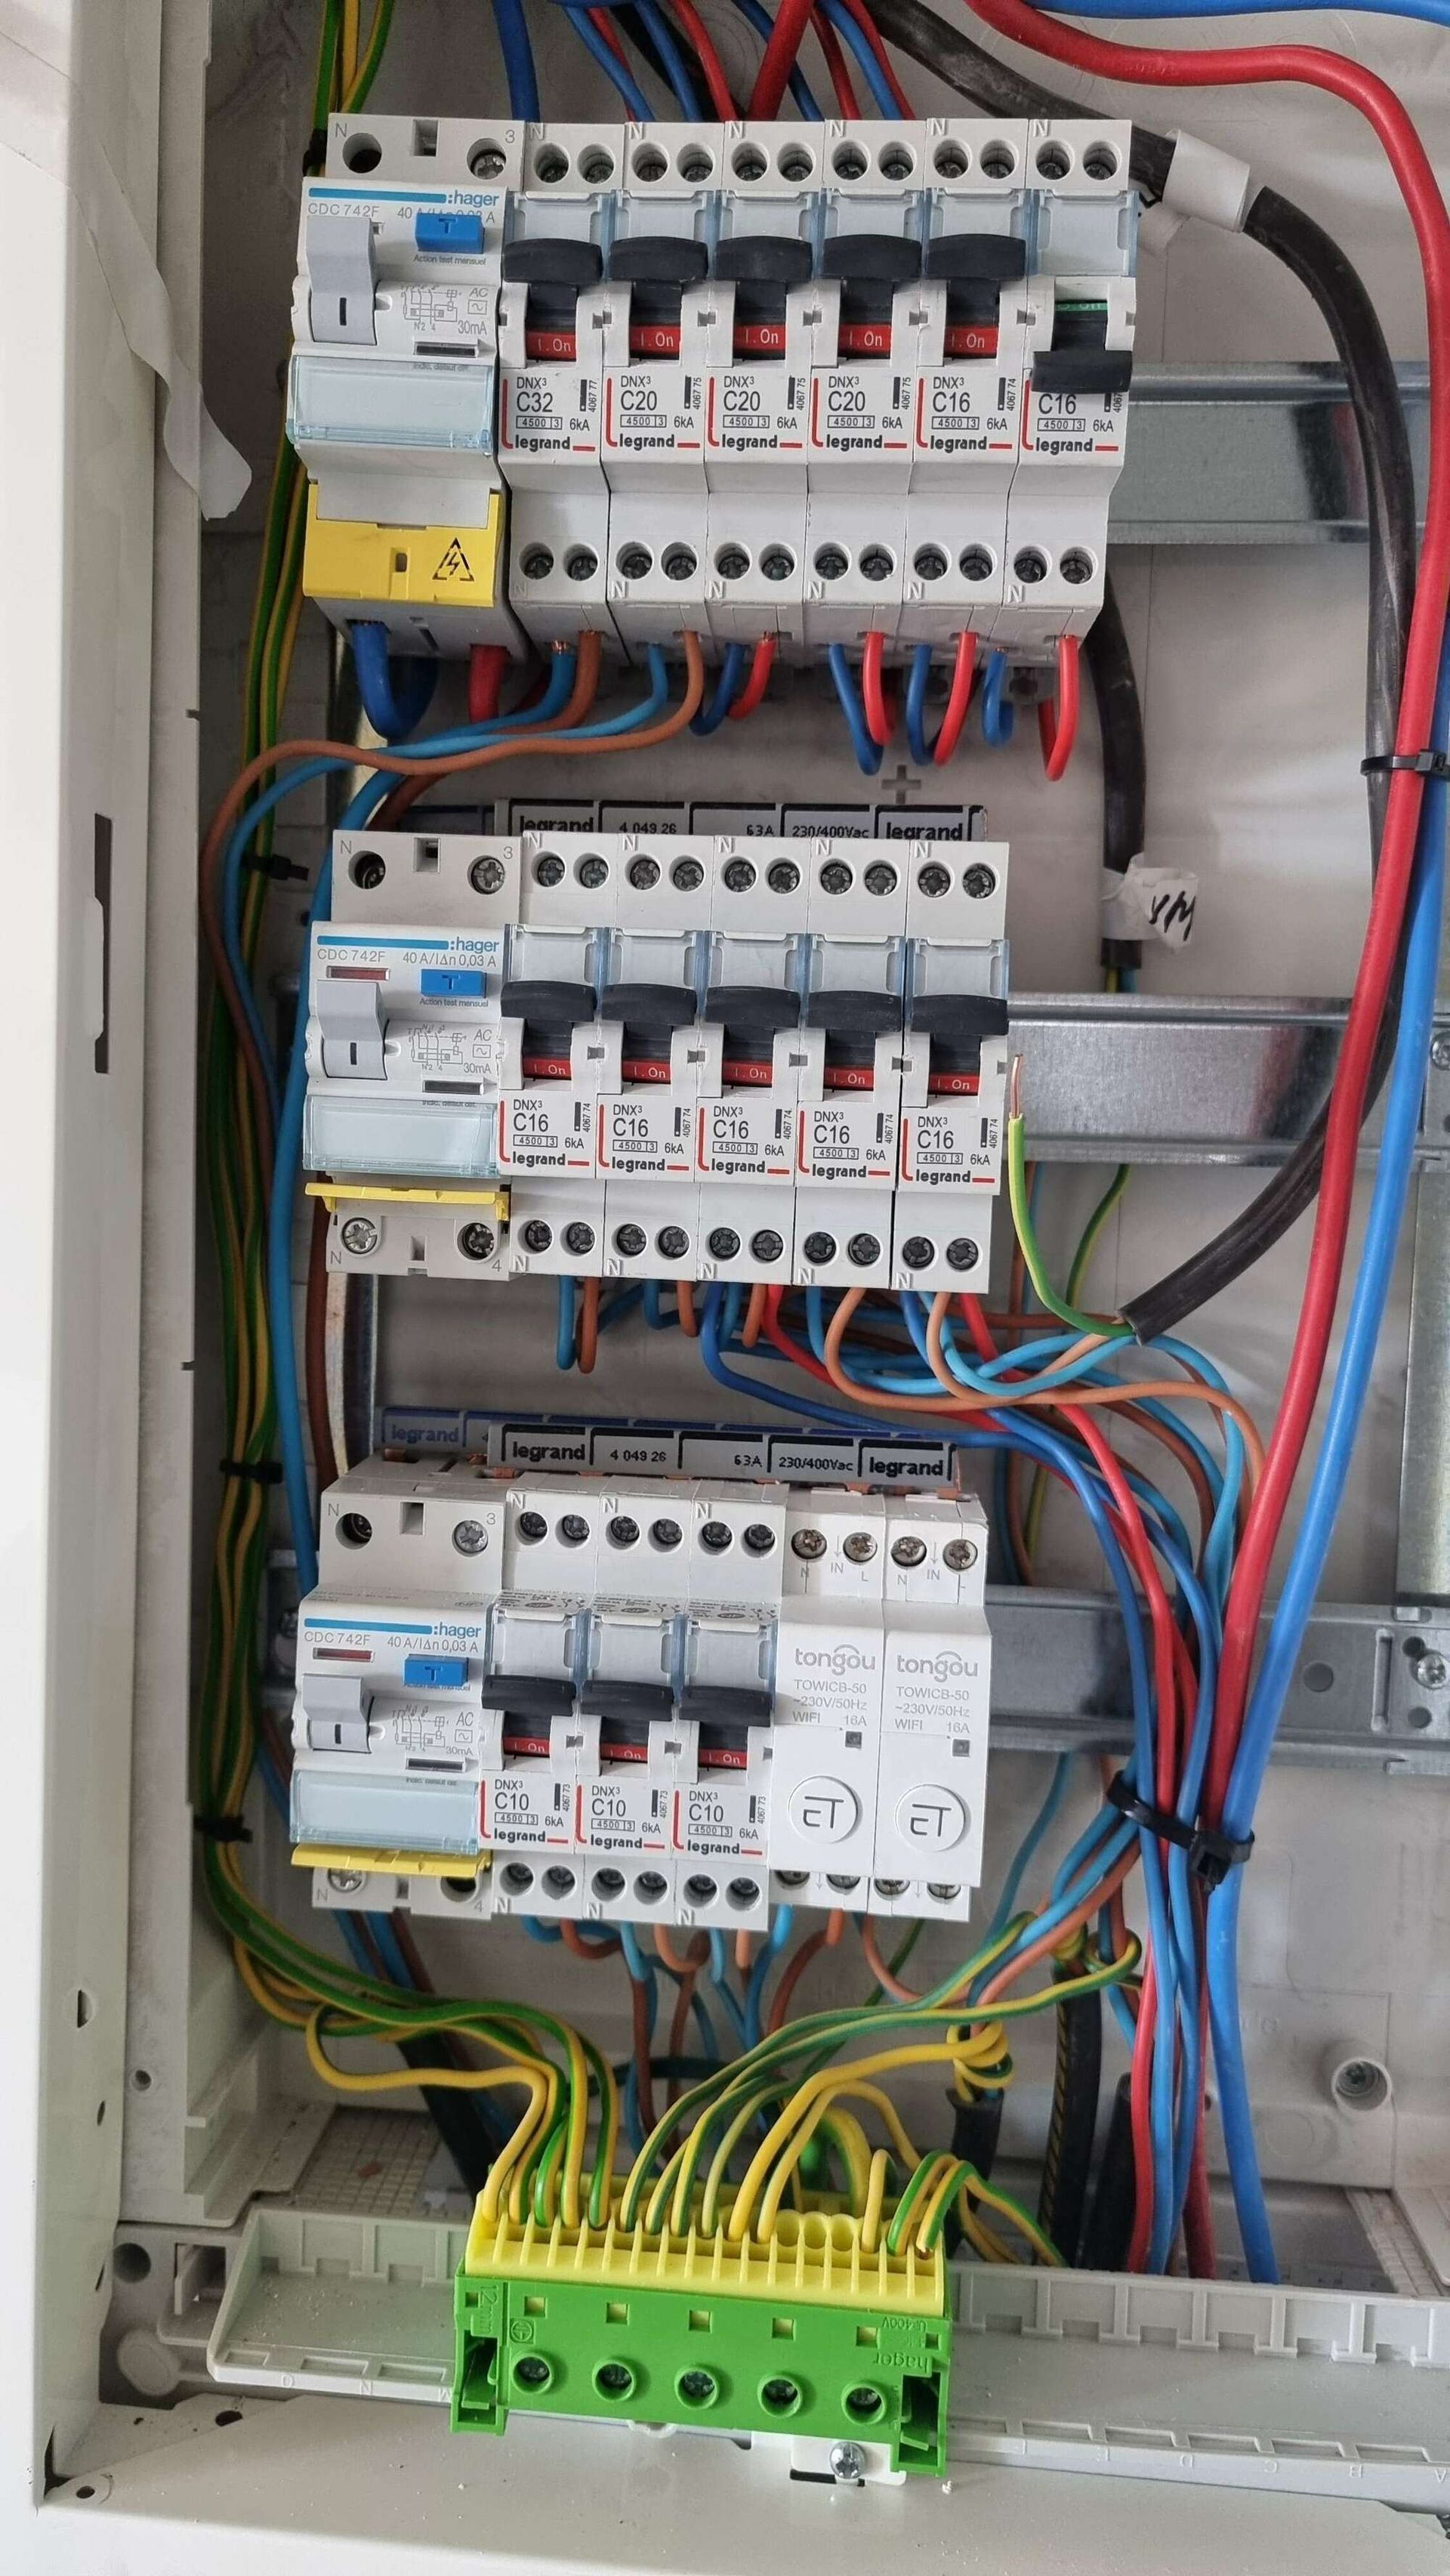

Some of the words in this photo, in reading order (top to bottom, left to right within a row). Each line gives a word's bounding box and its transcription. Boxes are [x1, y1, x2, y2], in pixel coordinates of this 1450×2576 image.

[335, 123, 347, 137] N
[505, 129, 515, 143] 3
[398, 208, 412, 218] 40
[470, 288, 488, 297] AC
[458, 320, 487, 335] 30mA
[517, 391, 553, 412] C32
[621, 390, 657, 411] C20
[723, 390, 760, 412] C20
[828, 391, 865, 412] C20
[933, 391, 970, 412] C16
[1038, 393, 1076, 415] C16
[522, 418, 546, 427] 4500
[569, 418, 590, 431] 6kA
[626, 416, 650, 425] 4500
[674, 415, 694, 428] 6kA
[729, 417, 753, 426] 4500
[777, 416, 798, 429] 6kA
[834, 417, 859, 426] 4500
[882, 416, 902, 429] 6kA
[938, 419, 963, 428] 4500
[986, 418, 1007, 431] 6kA
[1044, 420, 1069, 429] 4500
[1093, 419, 1113, 432] 6kA
[515, 434, 570, 452] legrand
[619, 433, 674, 451] legrand
[722, 434, 778, 452] legrand
[826, 434, 882, 452] legrand
[930, 435, 987, 453] legrand
[1036, 437, 1094, 456] legrand
[520, 816, 594, 831] legrand
[886, 823, 963, 841] legrand
[340, 840, 352, 854] N
[504, 846, 513, 859] 3
[487, 956, 496, 967] A
[474, 1030, 492, 1041] AC
[464, 1063, 491, 1073] 30mA
[514, 1112, 548, 1132] C16
[613, 1117, 648, 1138] C16
[713, 1120, 748, 1139] C16
[814, 1124, 850, 1144] C16
[918, 1129, 954, 1149] C16
[519, 1138, 541, 1146] 4500
[565, 1137, 585, 1149] 6kA
[619, 1142, 641, 1151] 4500
[665, 1142, 684, 1154] 6kA
[718, 1144, 742, 1153] 4500
[764, 1144, 785, 1157] 6kA
[513, 1151, 566, 1168] legrand
[819, 1149, 843, 1158] 4500
[865, 1149, 886, 1160] 6kA
[923, 1154, 947, 1163] 4500
[970, 1154, 990, 1166] 6kA
[612, 1156, 665, 1172] legrand
[711, 1158, 765, 1175] legrand
[813, 1163, 867, 1180] legrand
[916, 1169, 971, 1185] legrand
[391, 1425, 458, 1444] legrand
[513, 1441, 585, 1463] legrand
[869, 1456, 943, 1478] legrand
[329, 1503, 339, 1516] N
[486, 1513, 495, 1524] 3
[831, 1562, 844, 1573] IN
[927, 1570, 940, 1580] IN
[861, 1571, 868, 1582] L
[470, 1641, 478, 1652] A
[795, 1645, 875, 1676] tongou
[897, 1651, 977, 1682] tongou
[457, 1712, 474, 1726] AC
[793, 1711, 820, 1722] WIFI
[844, 1715, 867, 1726] 16A
[895, 1719, 923, 1730] WIFI
[947, 1722, 970, 1733] 16A
[446, 1747, 473, 1756] 30mA
[495, 1792, 529, 1811] C10
[592, 1798, 626, 1818] C10
[689, 1803, 723, 1822] C10
[500, 1815, 523, 1824] 4500
[545, 1816, 563, 1827] 6kA
[597, 1822, 619, 1830] 4500
[642, 1822, 661, 1833] 6kA
[494, 1827, 545, 1843] legrand
[694, 1827, 717, 1836] 4500
[739, 1828, 758, 1839] 6kA
[591, 1834, 642, 1849] legrand
[687, 1839, 739, 1855] legrand
